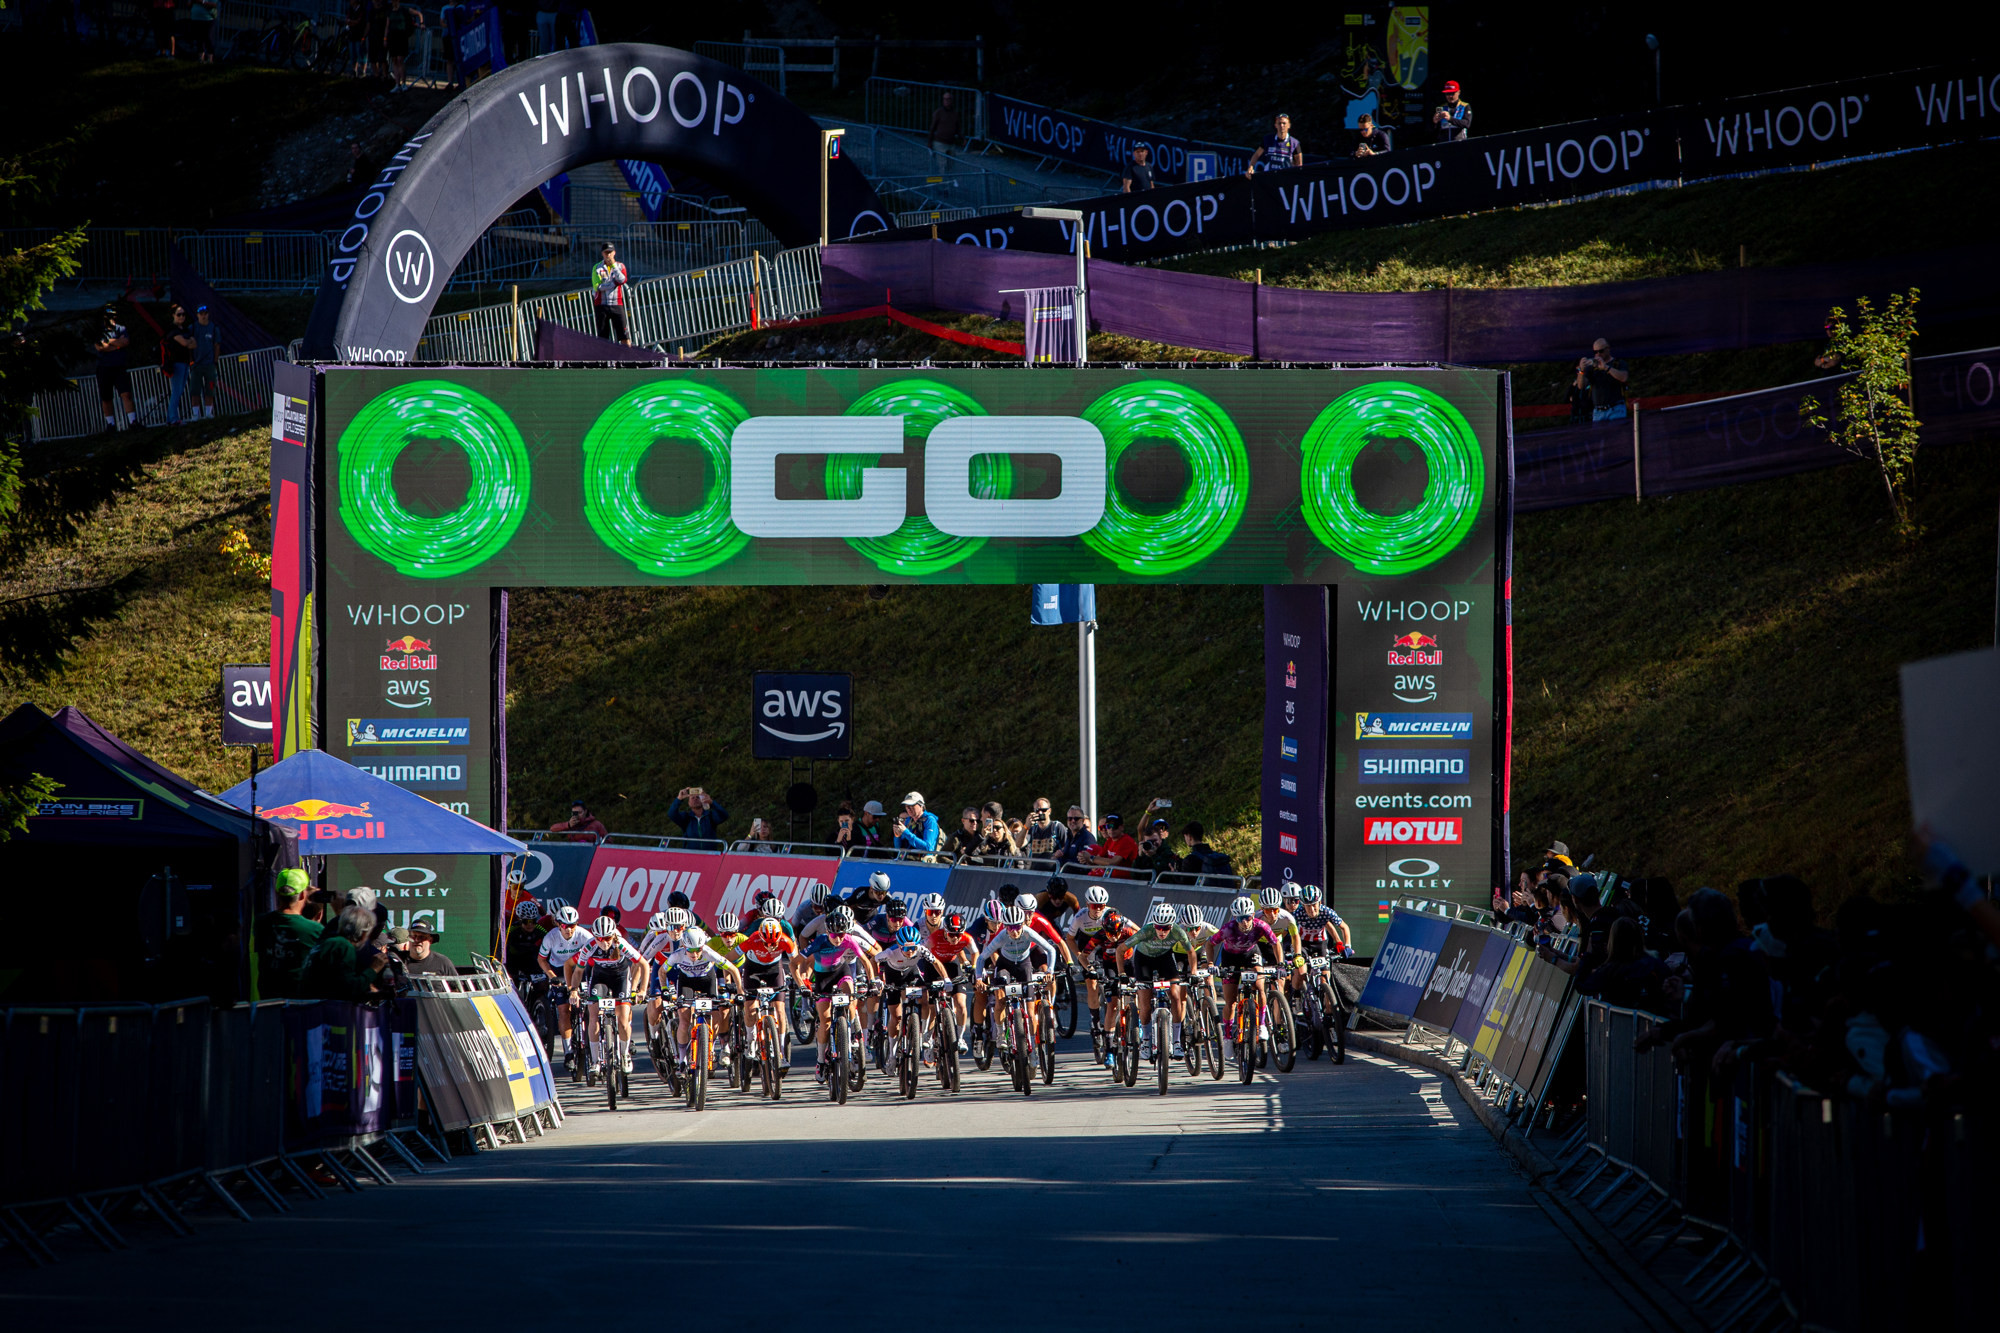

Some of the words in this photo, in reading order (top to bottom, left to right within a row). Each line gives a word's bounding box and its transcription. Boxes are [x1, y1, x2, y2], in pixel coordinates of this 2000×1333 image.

[518, 66, 746, 145] WHOOP
[1004, 106, 1084, 153] WHOOP
[1704, 96, 1864, 158] WHOOP
[1193, 157, 1207, 182] P
[1485, 129, 1645, 190] WHOOP
[1279, 161, 1436, 224] WHOOP
[330, 132, 433, 283] WHOOP
[1059, 194, 1219, 255] WHOOP
[731, 415, 1106, 538] GO
[347, 604, 466, 626] WHOOP
[1357, 601, 1471, 621] WHOOP
[380, 655, 408, 670] Red
[409, 655, 437, 670] Bull
[1388, 650, 1415, 665] Red
[1416, 650, 1442, 665] Bull
[387, 680, 430, 695] aws
[1394, 674, 1436, 690] aws
[763, 690, 842, 718] aws
[381, 727, 468, 738] MICHELIN
[1388, 722, 1471, 732] MICHELIN
[1363, 759, 1464, 774] SHIMANO
[1355, 792, 1472, 808] events.com
[316, 822, 385, 839] Bull
[1368, 821, 1458, 841] MOTUL
[1281, 835, 1297, 852] MOTUL
[588, 866, 701, 912] MOTUL
[1376, 879, 1452, 888] OAKLEY
[1312, 958, 1323, 966] 20
[1375, 942, 1437, 988] SHIMANO
